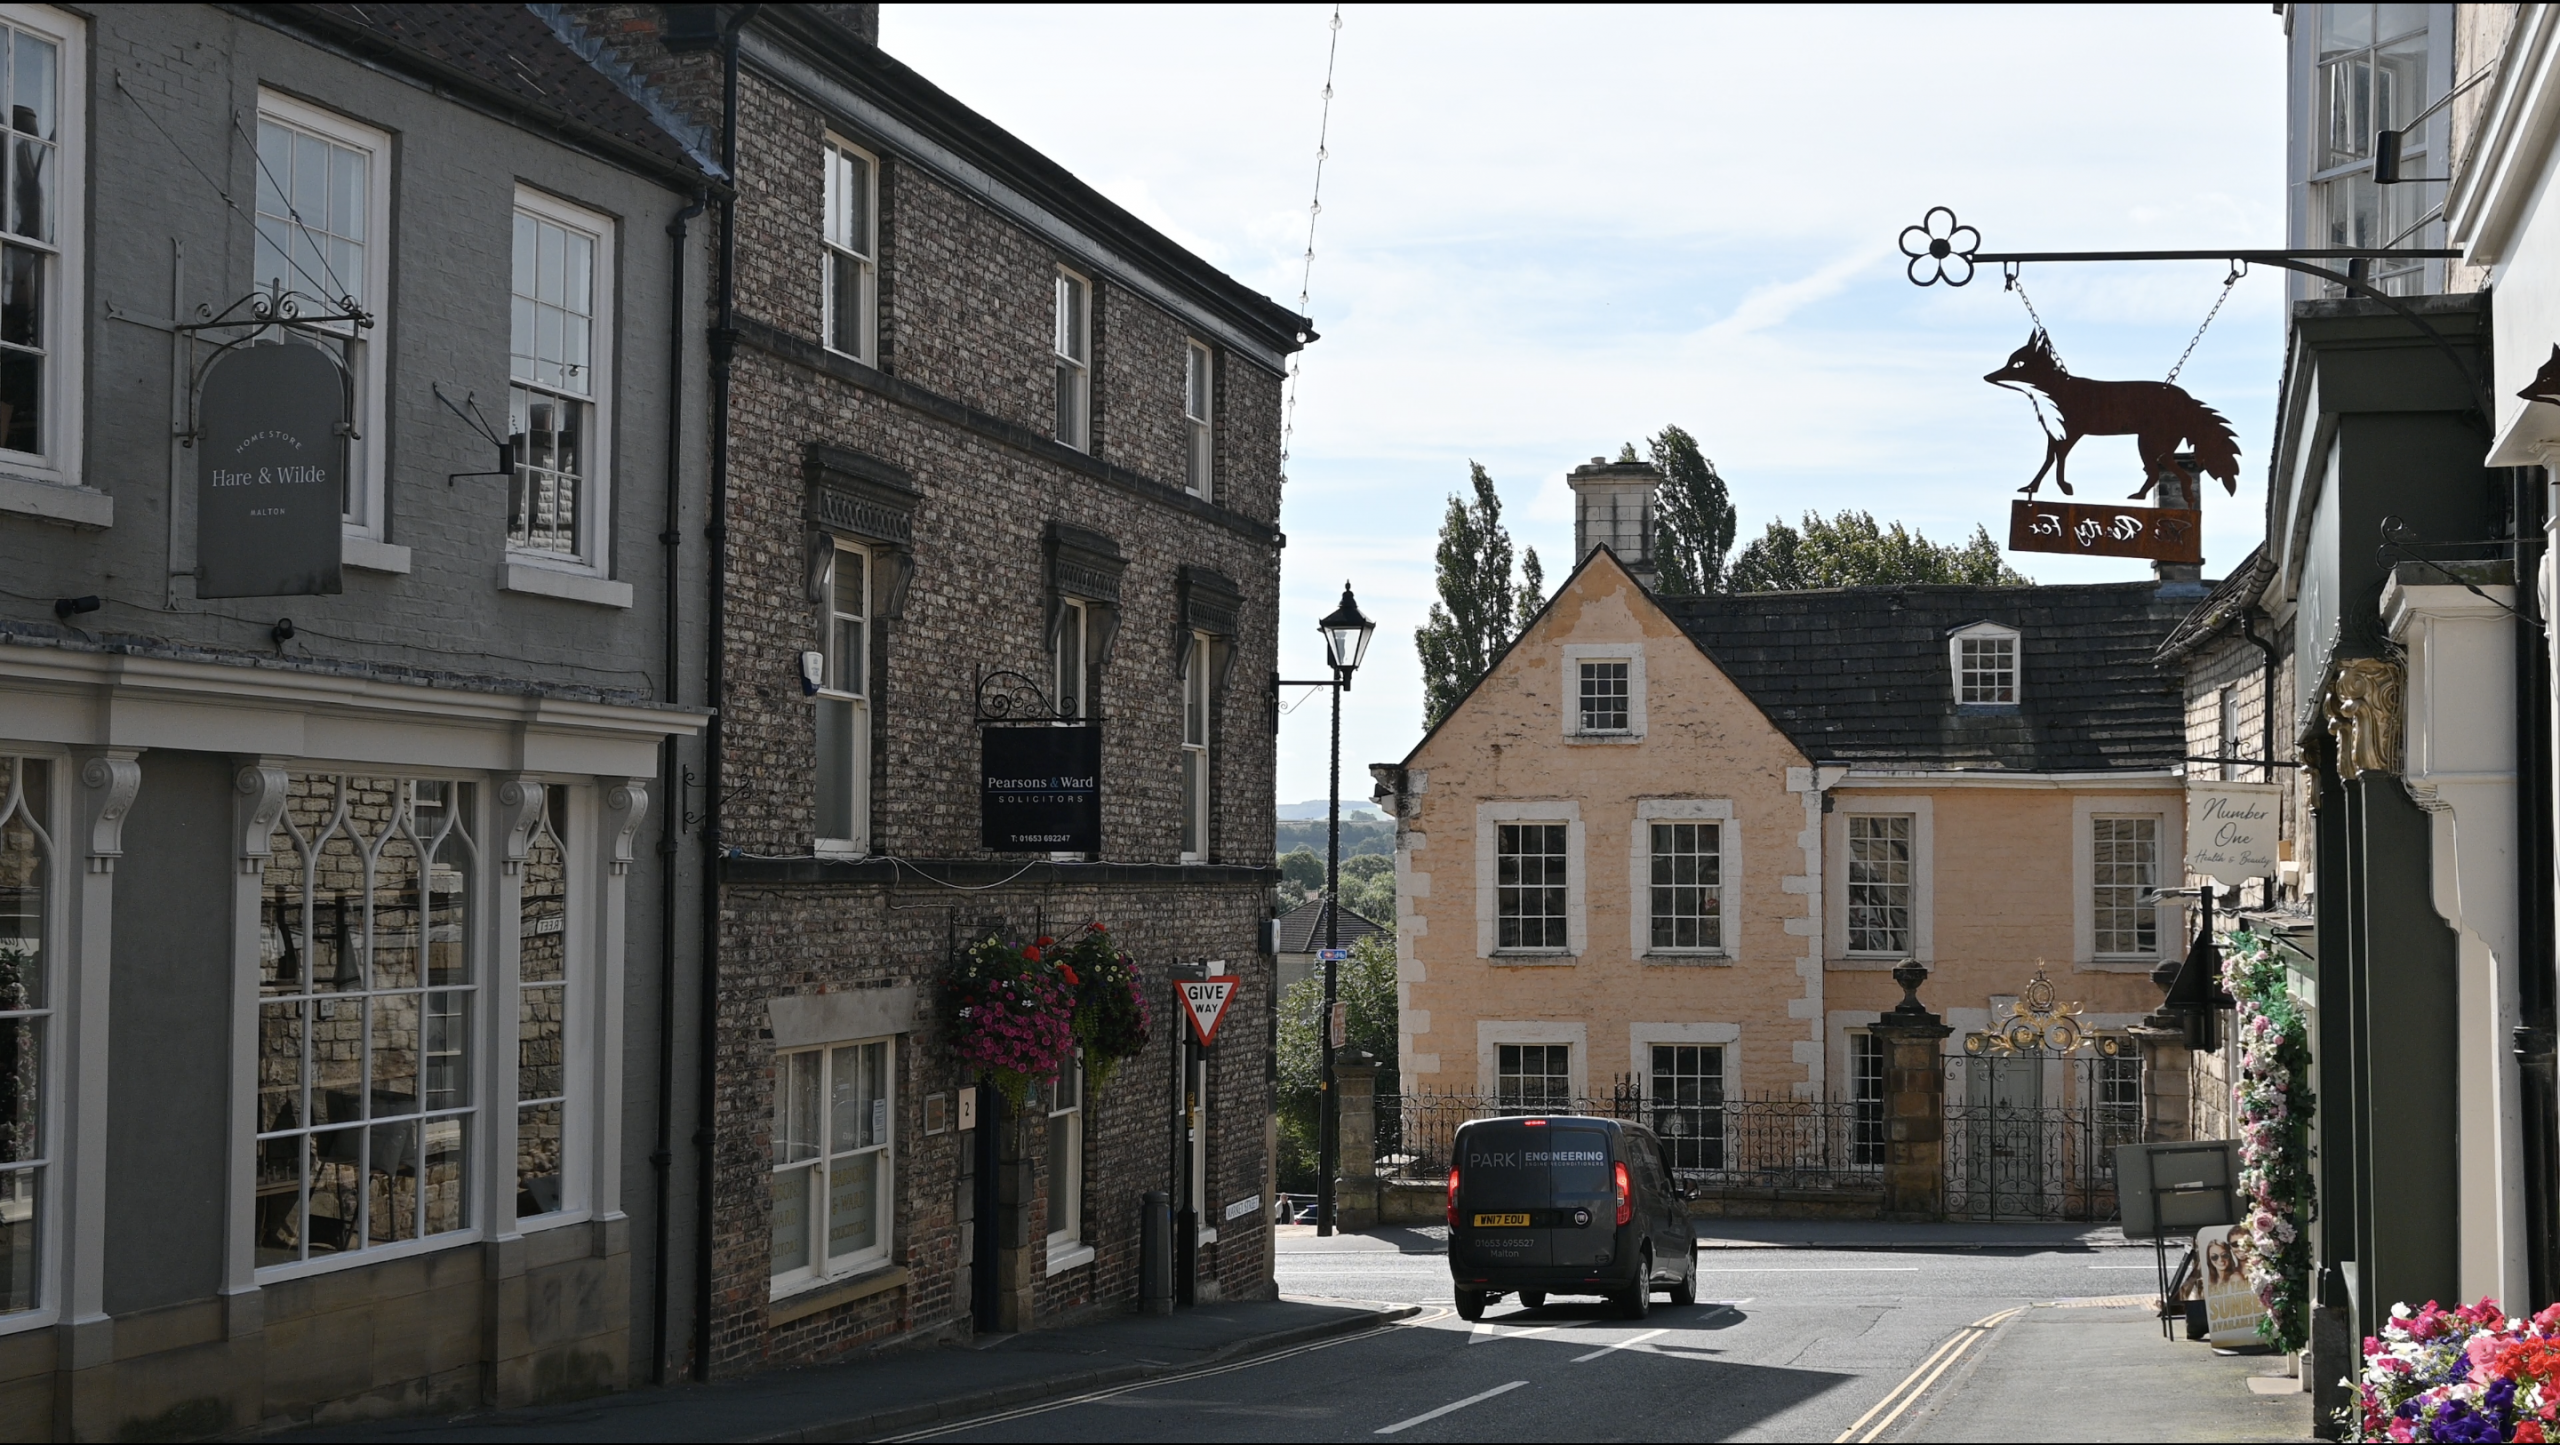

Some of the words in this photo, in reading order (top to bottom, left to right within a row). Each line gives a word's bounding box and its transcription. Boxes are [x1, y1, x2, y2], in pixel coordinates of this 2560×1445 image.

[236, 431, 265, 454] HOME
[269, 430, 303, 450] STORE
[212, 469, 252, 487] Hare
[258, 466, 272, 484] &
[277, 465, 326, 484] Wilde
[250, 507, 286, 516] MALTON
[988, 777, 1047, 789] Pearsons
[1049, 776, 1059, 788] &
[1060, 776, 1094, 788] Ward
[998, 795, 1084, 803] SOLICITORS
[2202, 797, 2269, 821] Number
[1011, 834, 1018, 842] T:
[1019, 834, 1042, 842] 01653
[1043, 834, 1071, 842] 692247
[2215, 821, 2254, 848] One
[2194, 849, 2225, 864] Health
[2238, 850, 2273, 869] Beauty
[1188, 985, 1224, 1000] GIVE
[1195, 1003, 1218, 1013] WAY
[964, 1101, 970, 1117] 2
[1470, 1152, 1516, 1168] PARK
[1525, 1151, 1604, 1161] ENGINEERING
[1480, 1215, 1502, 1225] WN17
[1504, 1214, 1524, 1225] EOU
[1475, 1239, 1500, 1247] 01653
[1502, 1239, 1535, 1247] 695527
[1490, 1249, 1520, 1258] Malton
[2211, 1316, 2254, 1333] AVAILABLE
